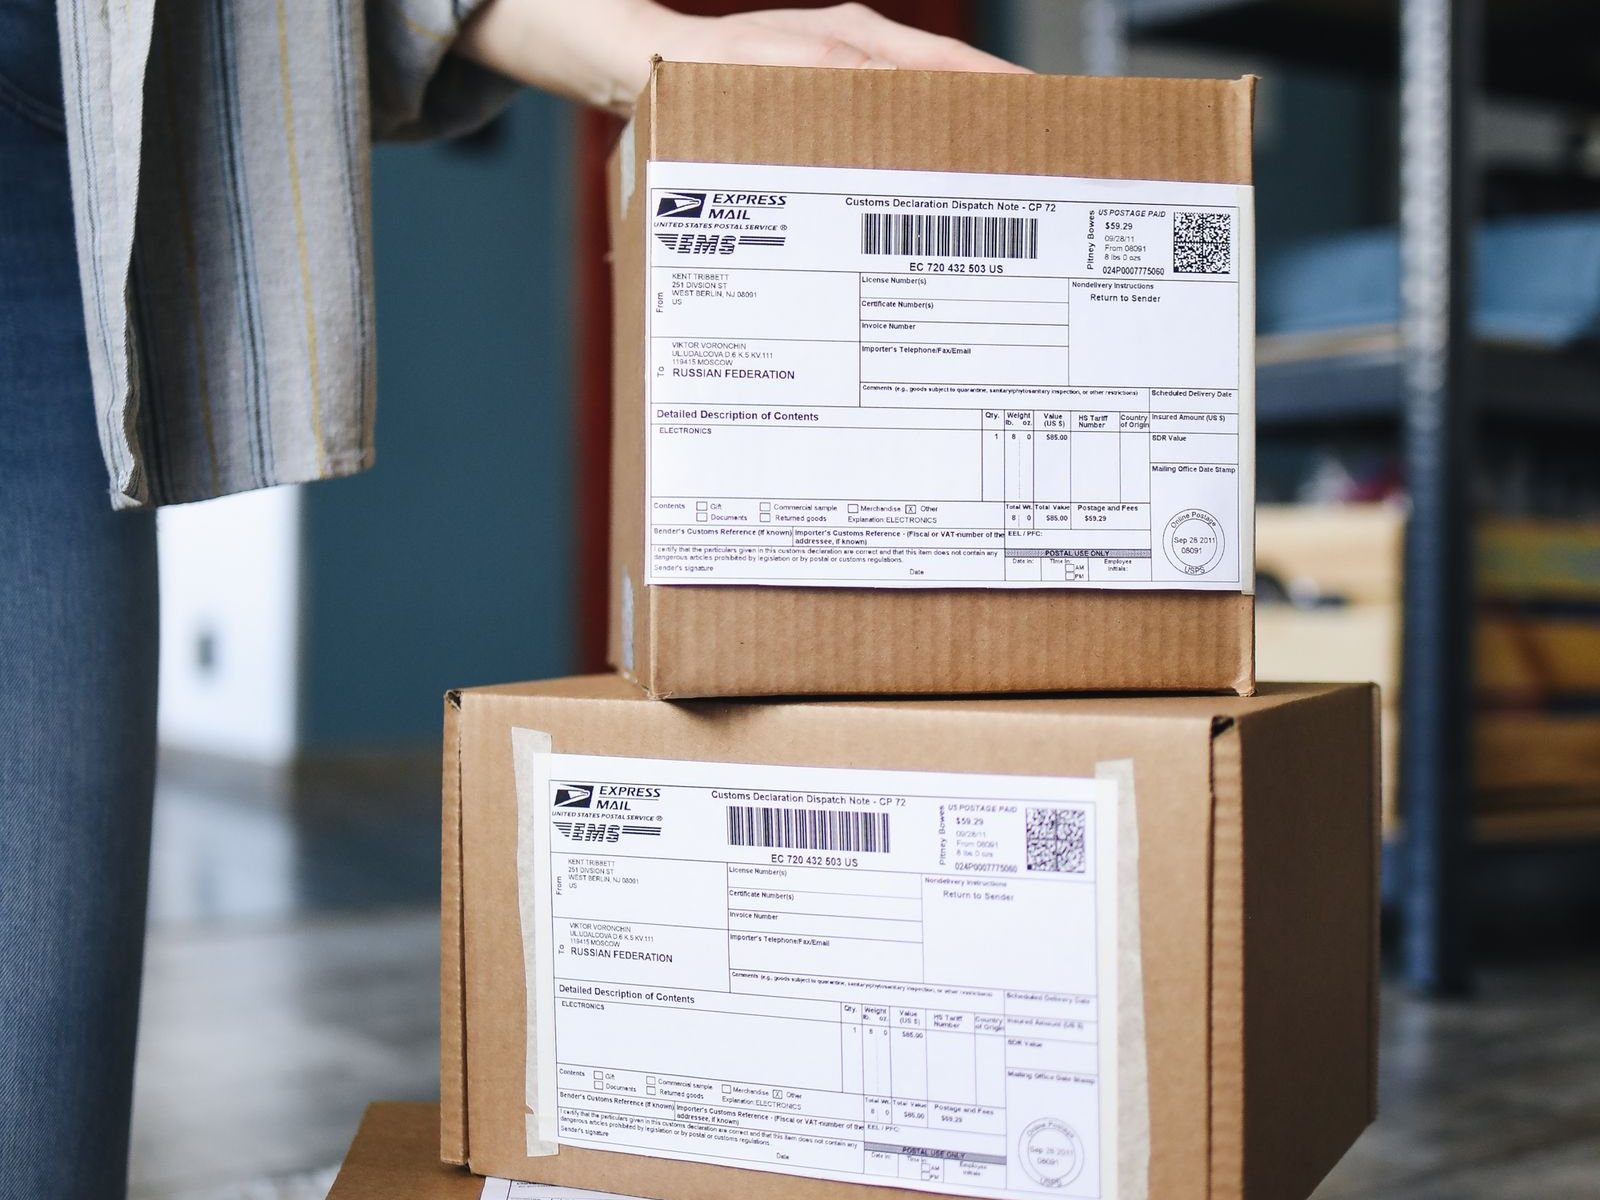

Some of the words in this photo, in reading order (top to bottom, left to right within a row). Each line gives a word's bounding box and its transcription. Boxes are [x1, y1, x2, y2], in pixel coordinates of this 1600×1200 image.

[713, 194, 787, 206] EXPRESS
[845, 197, 890, 207] Customs
[893, 198, 948, 208] Declaration
[952, 200, 994, 211] Dispatch
[997, 202, 1019, 211] Note
[1028, 203, 1042, 212] CP
[1045, 203, 1056, 212] 72
[708, 209, 750, 220] MAIL
[1109, 209, 1146, 217] POSTAGE
[1105, 222, 1133, 230] $59.29
[678, 234, 736, 255] EMS
[1105, 244, 1123, 252] From
[1087, 242, 1095, 269] Pitney
[910, 262, 924, 272] EC
[927, 263, 945, 272] 720
[948, 263, 966, 273] 432
[969, 264, 986, 274] 503
[989, 265, 1004, 274] US
[890, 277, 927, 286] Number(s)
[1072, 281, 1113, 290] Nondelivery
[656, 292, 664, 313] From
[1090, 293, 1118, 302] Return
[1132, 294, 1160, 303] Sender
[898, 301, 934, 310] Number(s)
[658, 366, 665, 377] To
[673, 368, 722, 378] RUSSIAN
[725, 369, 795, 380] FEDERATION
[1188, 389, 1216, 398] Delivery
[1216, 390, 1234, 398] Date
[657, 410, 697, 419] Detailed
[700, 410, 758, 421] Description
[761, 411, 772, 420] of
[774, 412, 819, 422] Contents
[1121, 414, 1148, 422] Country
[1152, 466, 1177, 474] Mailing
[1077, 503, 1106, 512] Postage
[1107, 503, 1121, 512] and
[1171, 512, 1191, 529] Online
[1192, 512, 1217, 528] Postage
[1184, 566, 1206, 574] USPS
[599, 786, 661, 798] EXPRESS
[711, 790, 751, 800] Customs
[753, 792, 804, 802] Declaration
[807, 794, 846, 805] Dispatch
[849, 796, 870, 805] Note
[879, 797, 892, 806] CP
[896, 798, 906, 806] 72
[596, 800, 631, 811] MAIL
[572, 823, 620, 842] EMS
[771, 854, 784, 864] EC
[787, 855, 804, 864] 720
[806, 856, 822, 866] 432
[825, 857, 842, 866] 503
[845, 858, 858, 867] US
[754, 868, 787, 877] Number(s)
[728, 890, 760, 898] Certificate
[762, 892, 794, 901] Number(s)
[943, 890, 971, 899] Return
[985, 892, 1014, 901] Sender
[754, 911, 779, 920] Number
[559, 945, 564, 953] To
[571, 947, 611, 958] RUSSIAN
[613, 950, 673, 963] FEDERATION
[559, 984, 592, 995] Detailed
[594, 987, 642, 999] Description
[645, 992, 654, 1000] of
[656, 992, 695, 1004] Contents
[562, 1000, 605, 1010] ELECTRONICS
